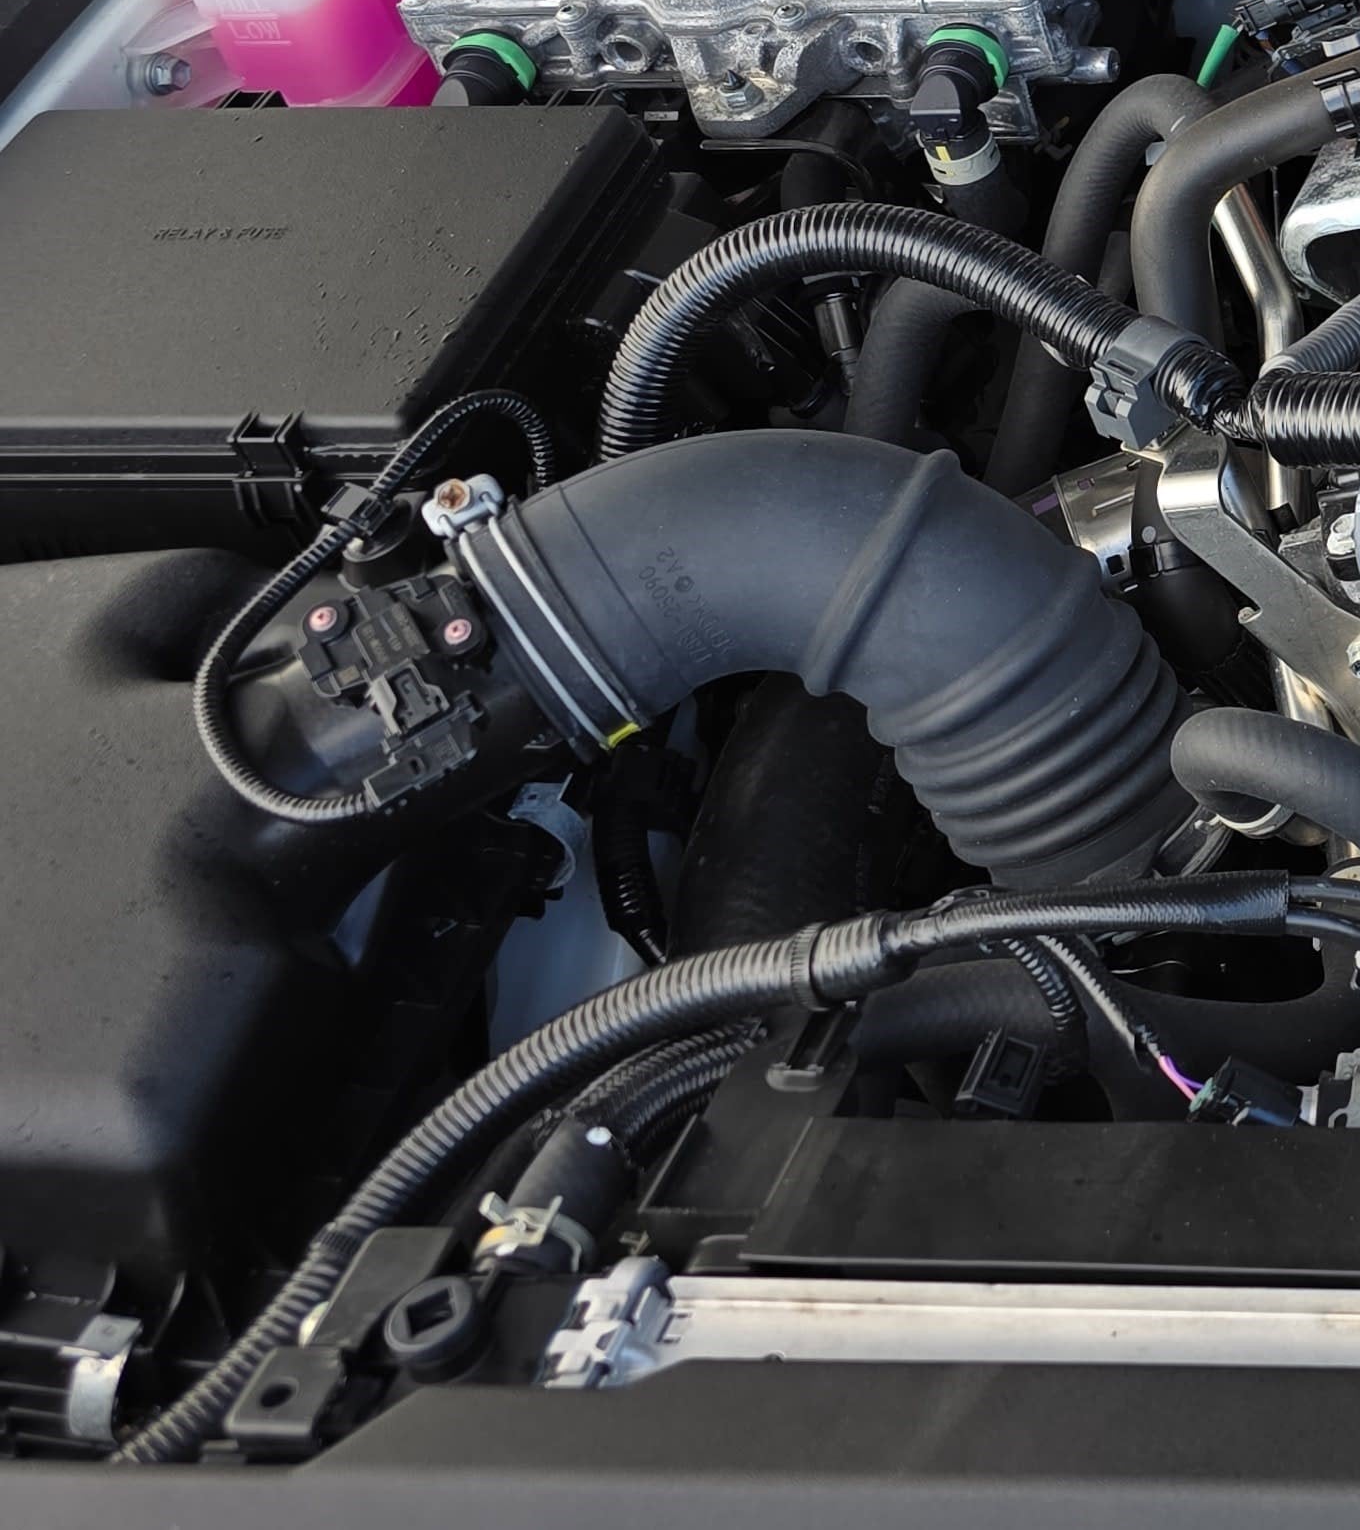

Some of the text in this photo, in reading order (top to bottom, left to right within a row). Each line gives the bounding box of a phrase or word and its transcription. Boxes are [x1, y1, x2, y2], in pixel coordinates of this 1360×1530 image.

[227, 21, 281, 39] LOW
[153, 227, 218, 241] RELAY
[236, 227, 289, 241] FUSE
